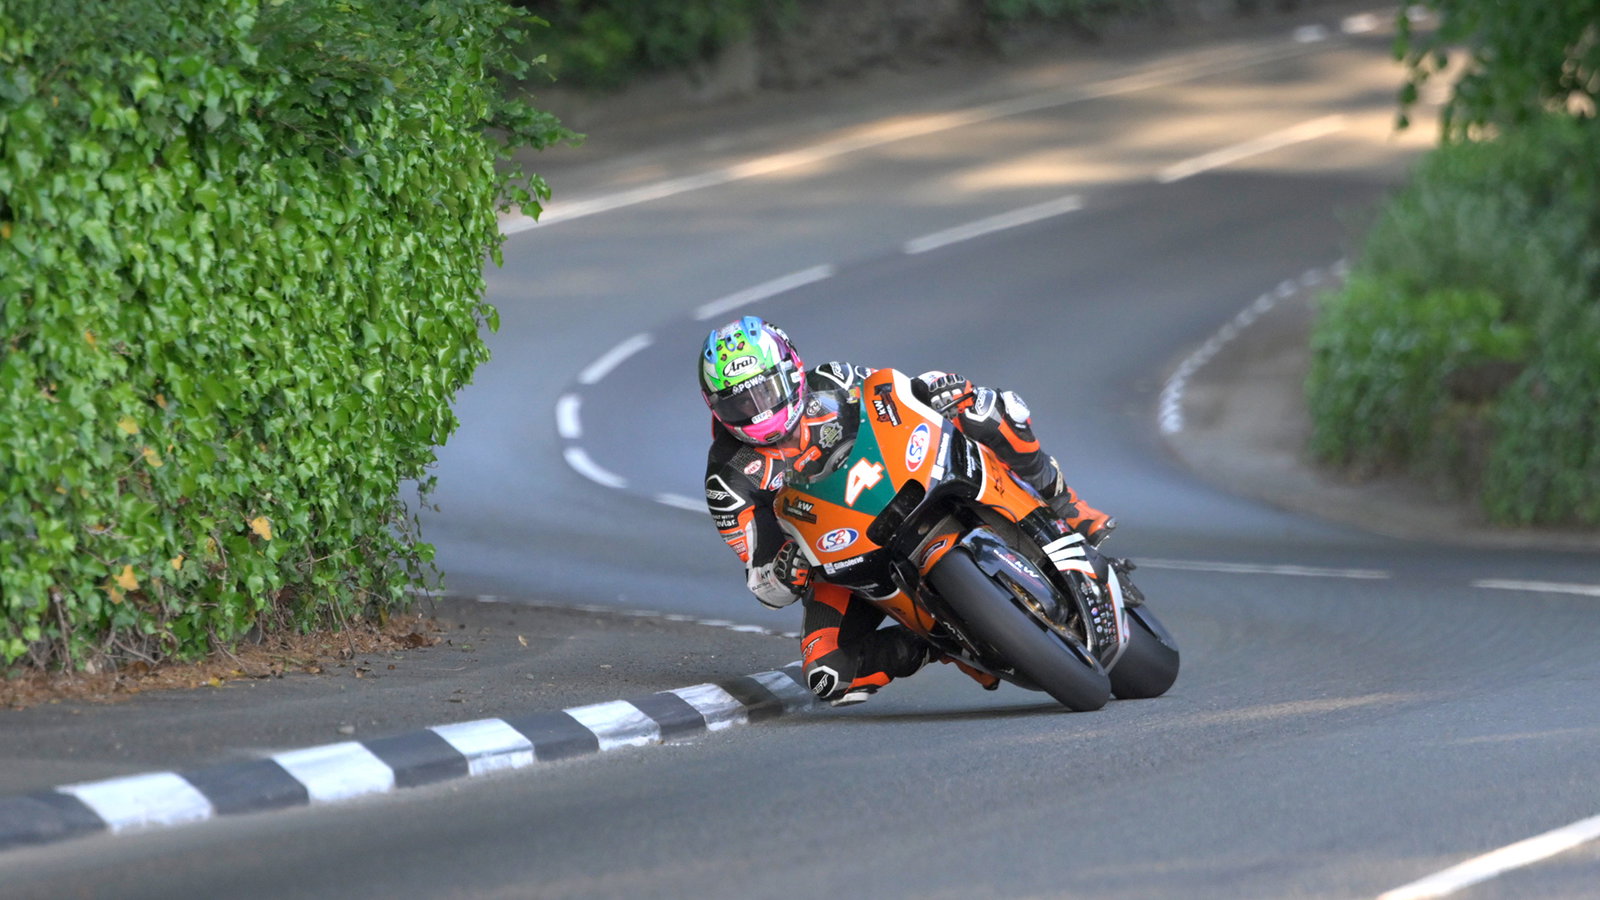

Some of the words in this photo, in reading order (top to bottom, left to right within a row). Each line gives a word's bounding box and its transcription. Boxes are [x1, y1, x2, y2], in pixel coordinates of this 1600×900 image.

[726, 356, 753, 376] Arai
[845, 457, 885, 507] 4
[715, 519, 737, 528] evlar
